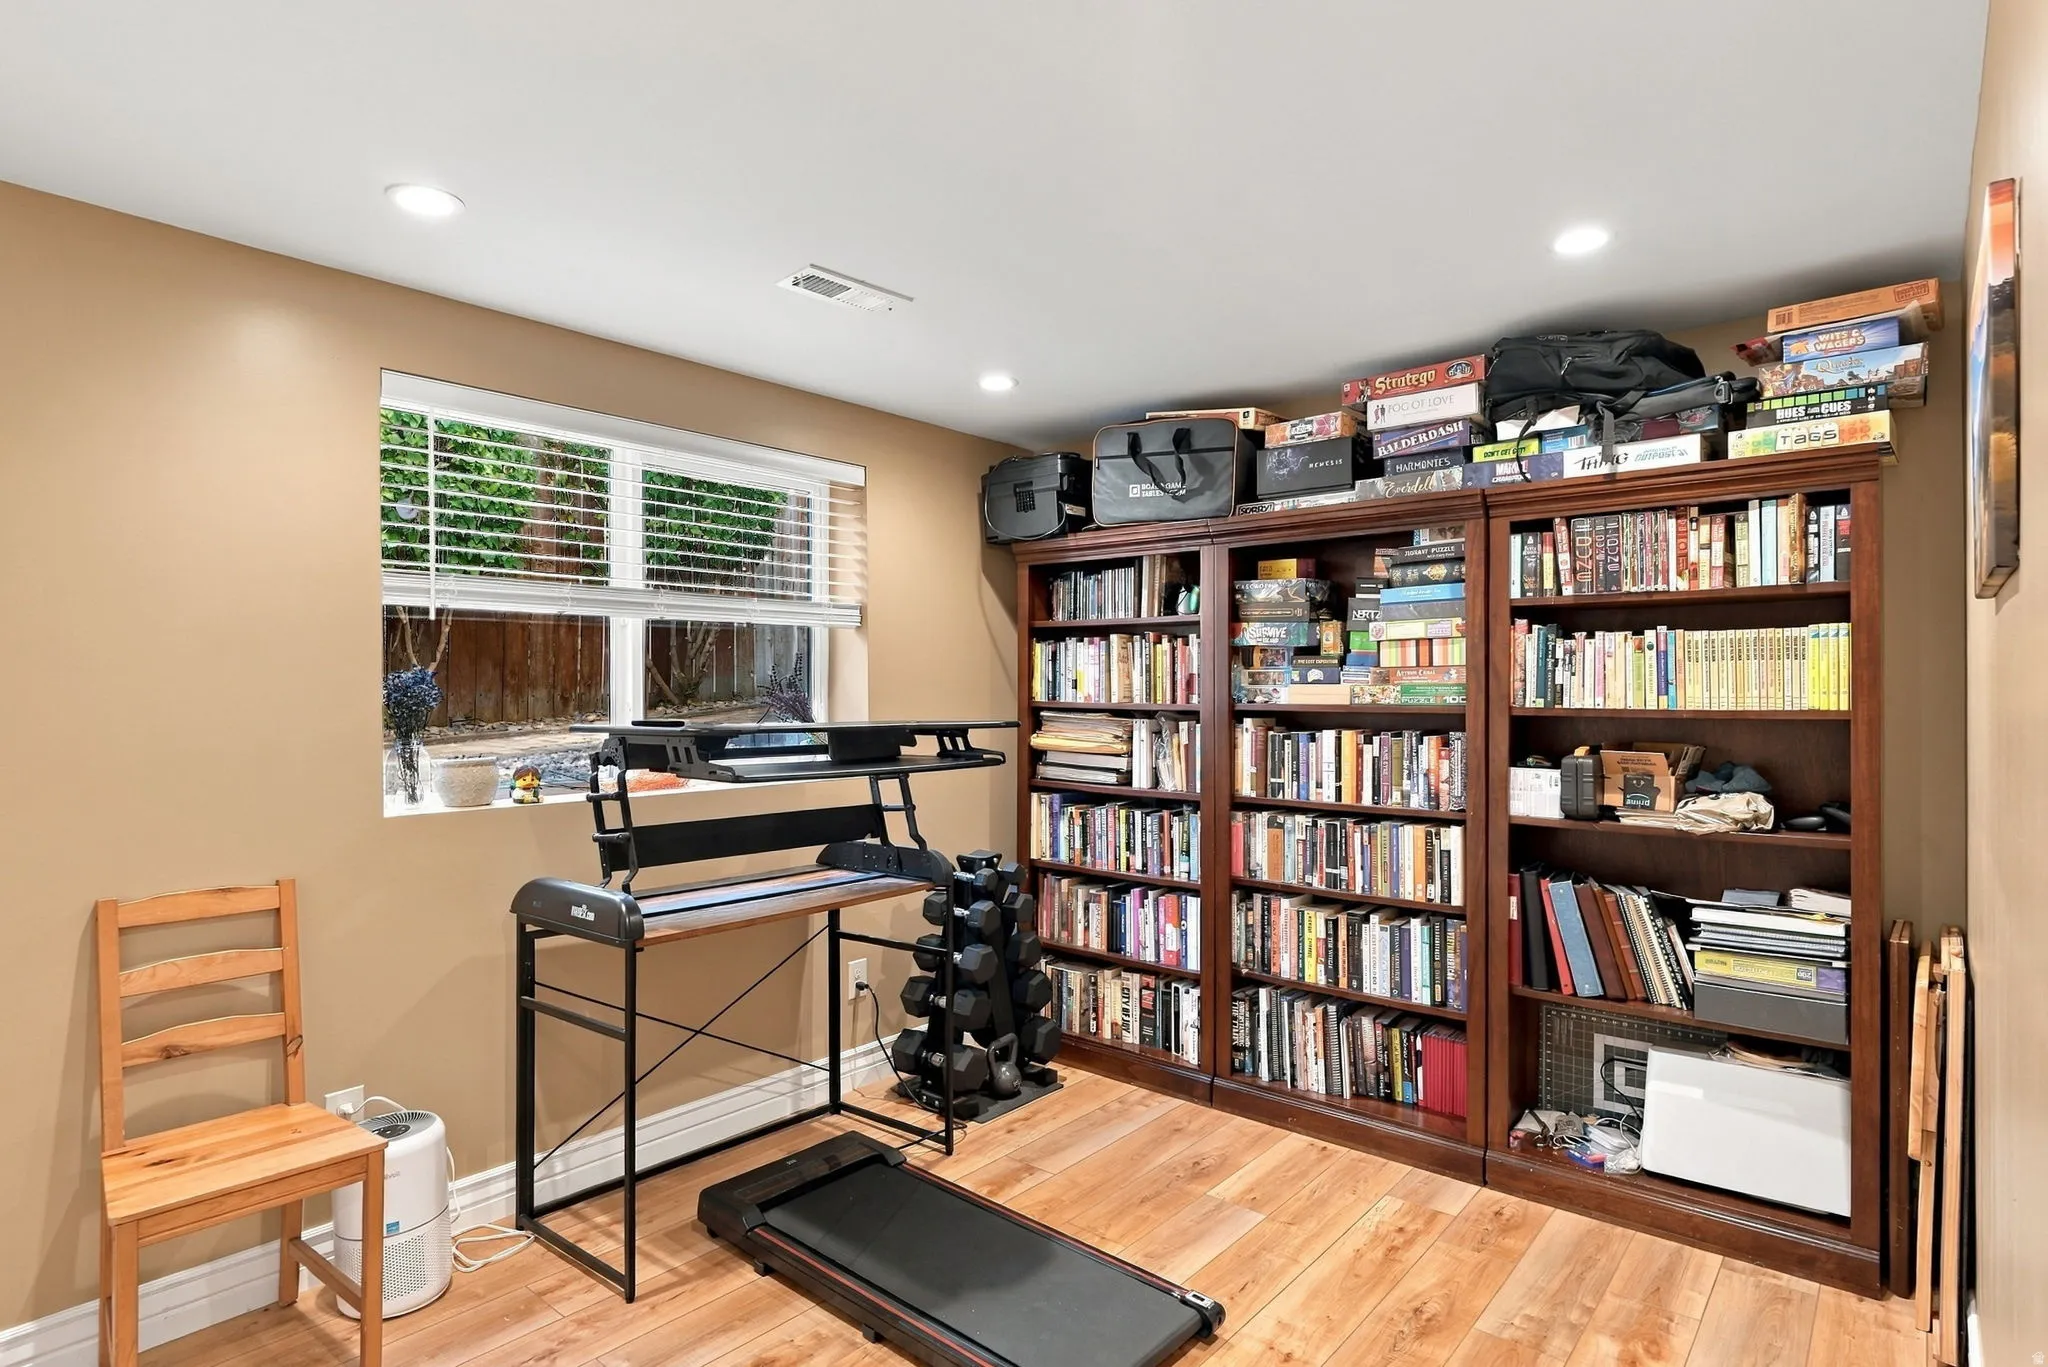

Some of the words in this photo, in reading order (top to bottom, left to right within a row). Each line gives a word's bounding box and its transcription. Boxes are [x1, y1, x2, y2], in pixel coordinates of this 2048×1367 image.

[1815, 336, 1865, 350] WAGERS
[1817, 330, 1848, 341] WITS
[1374, 369, 1437, 395] Stratego
[1387, 401, 1409, 414] FOG
[1411, 398, 1427, 411] OF
[1428, 395, 1455, 407] LOVE
[1776, 406, 1806, 420] HUES
[1820, 400, 1852, 414] CUES
[1377, 420, 1465, 457] BALDERDASH
[1309, 459, 1343, 468] NEMESIS
[1395, 457, 1452, 473] HARMONIES
[1384, 472, 1437, 498] Everdell
[1240, 504, 1273, 515] SORRY!
[1431, 545, 1455, 554] PUZZLE
[1401, 696, 1436, 704] PUZZLE
[1625, 799, 1651, 807] prime
[1122, 987, 1131, 1006] CITY
[1122, 1007, 1130, 1017] OF
[1122, 1017, 1131, 1034] JOY
